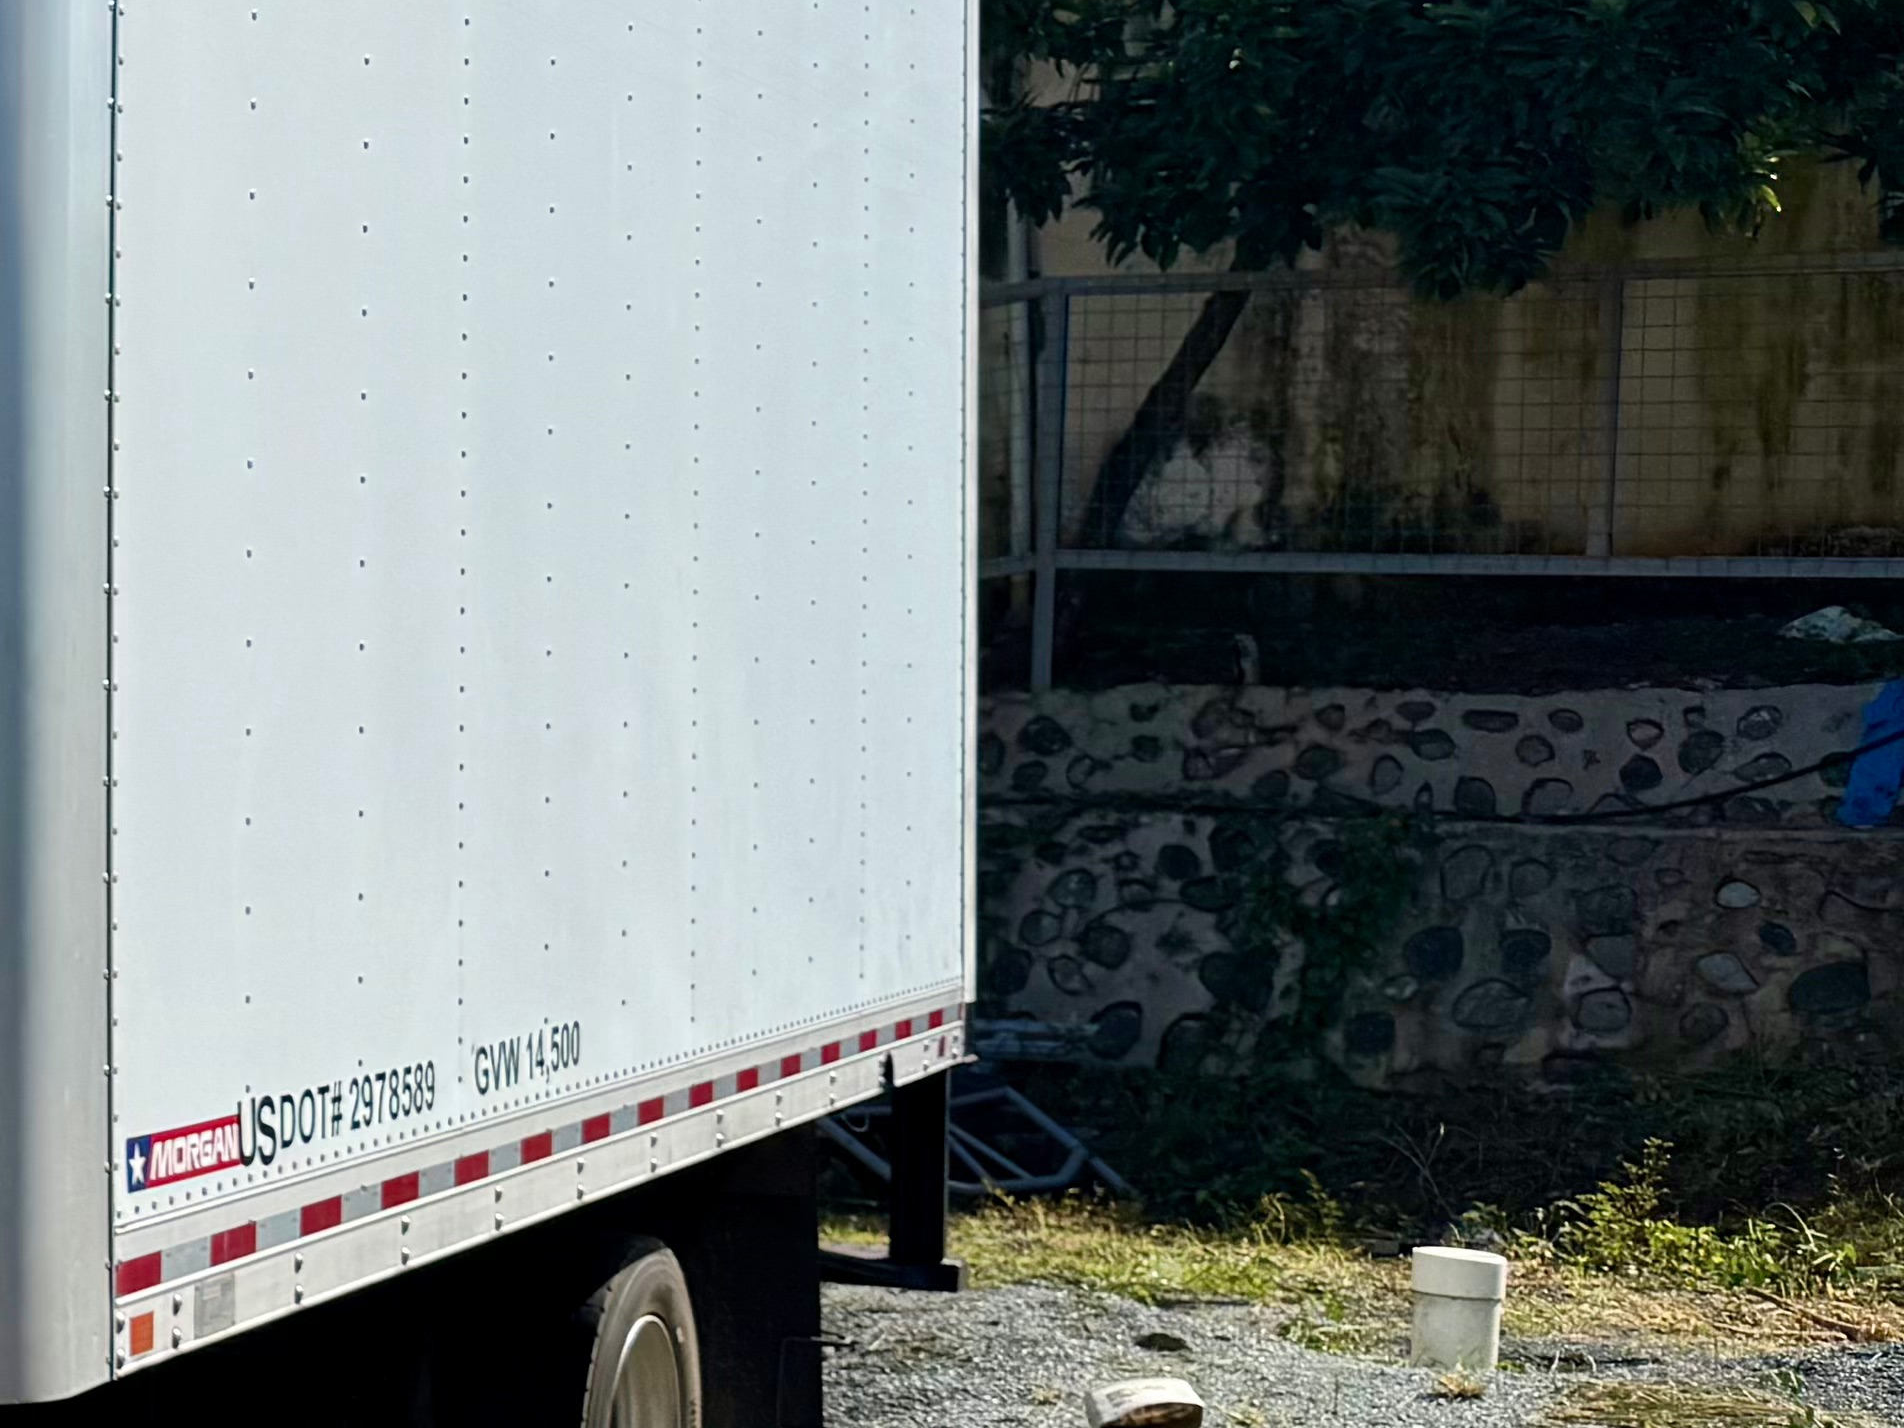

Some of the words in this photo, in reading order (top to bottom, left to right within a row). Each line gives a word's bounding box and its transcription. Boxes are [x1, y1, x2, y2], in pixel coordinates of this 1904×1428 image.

[474, 1036, 520, 1095] GVW
[526, 1020, 580, 1084] 14,500
[237, 1080, 342, 1166] USDOT#
[349, 1060, 435, 1130] 2978589
[149, 1122, 239, 1181] MORGAN
